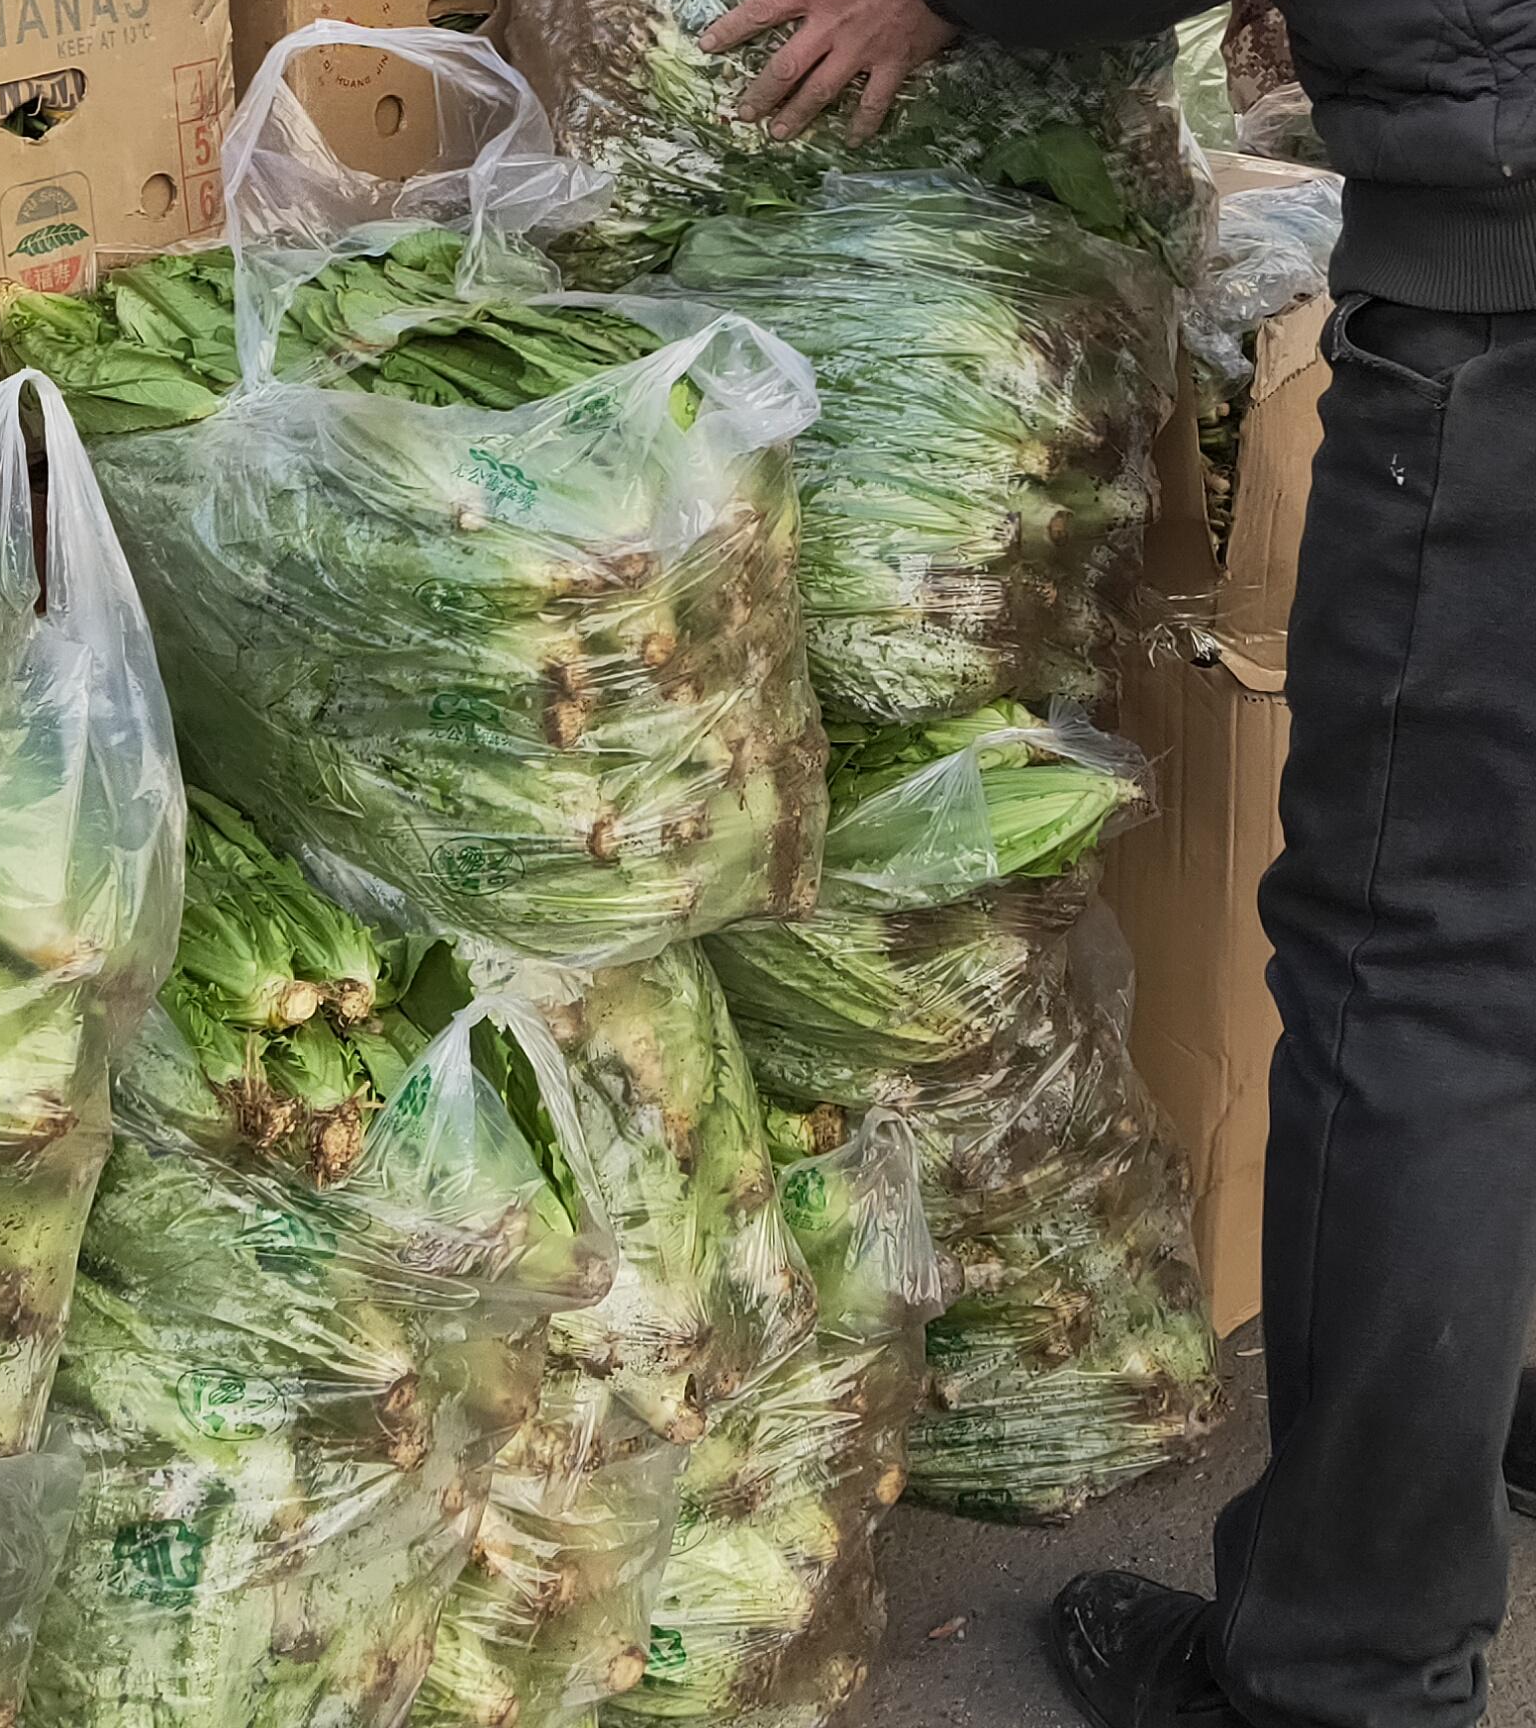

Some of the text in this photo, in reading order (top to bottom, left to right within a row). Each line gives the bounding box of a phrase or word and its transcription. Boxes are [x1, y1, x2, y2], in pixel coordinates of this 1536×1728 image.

[57, 36, 94, 59] KEEP
[100, 29, 117, 52] AT
[195, 126, 211, 166] 5
[200, 180, 214, 222] 6
[34, 262, 71, 290] 福寿
